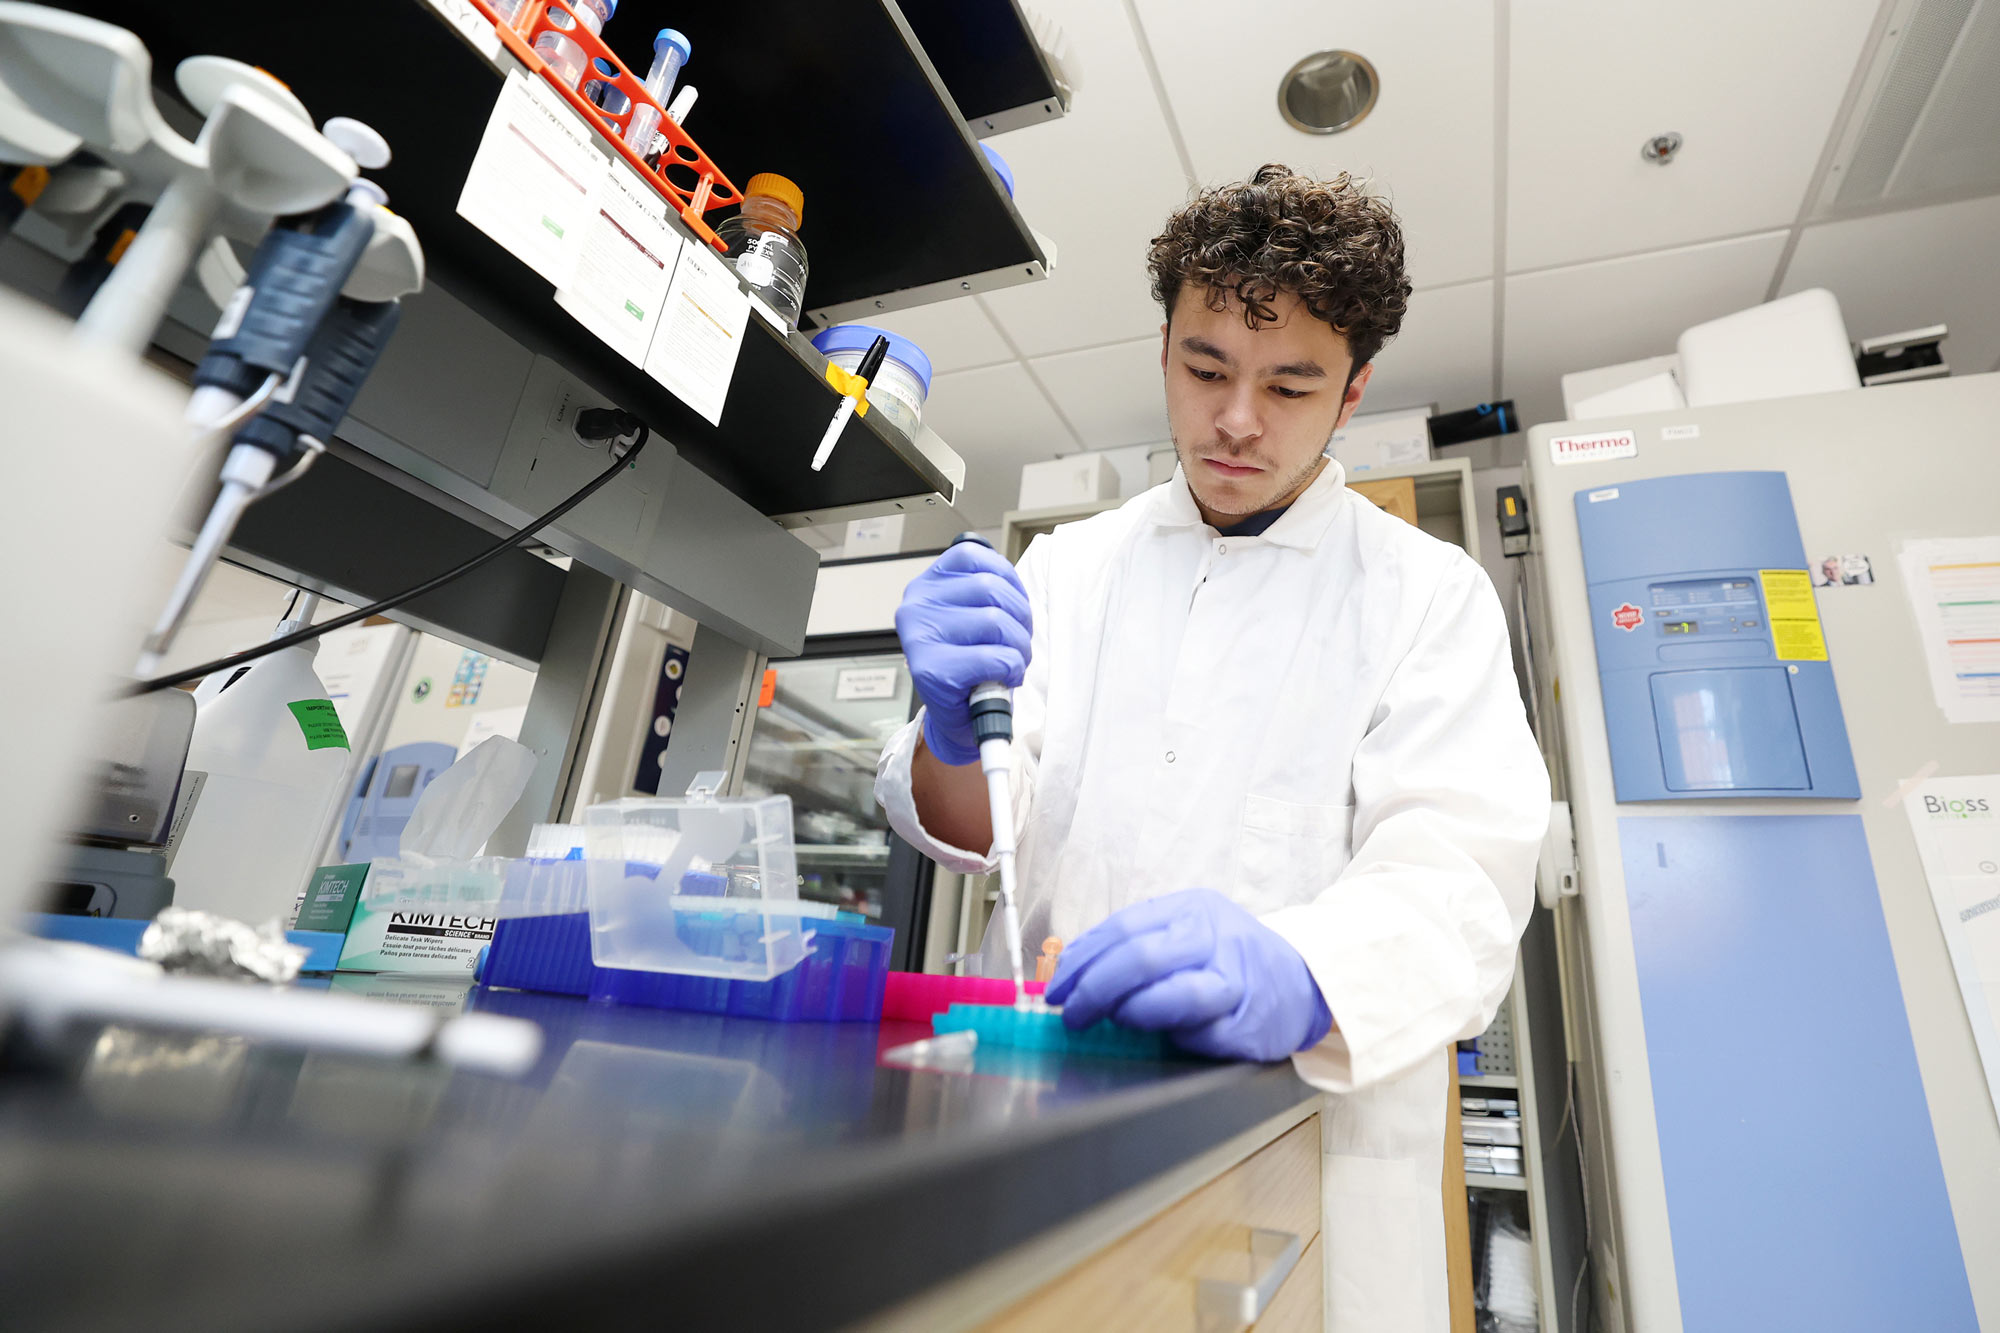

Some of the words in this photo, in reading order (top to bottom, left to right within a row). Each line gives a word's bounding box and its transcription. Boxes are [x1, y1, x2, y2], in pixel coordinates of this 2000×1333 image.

[1556, 436, 1630, 453] Thermo
[1924, 795, 1989, 813] Bioss
[424, 937, 443, 945] Wipers
